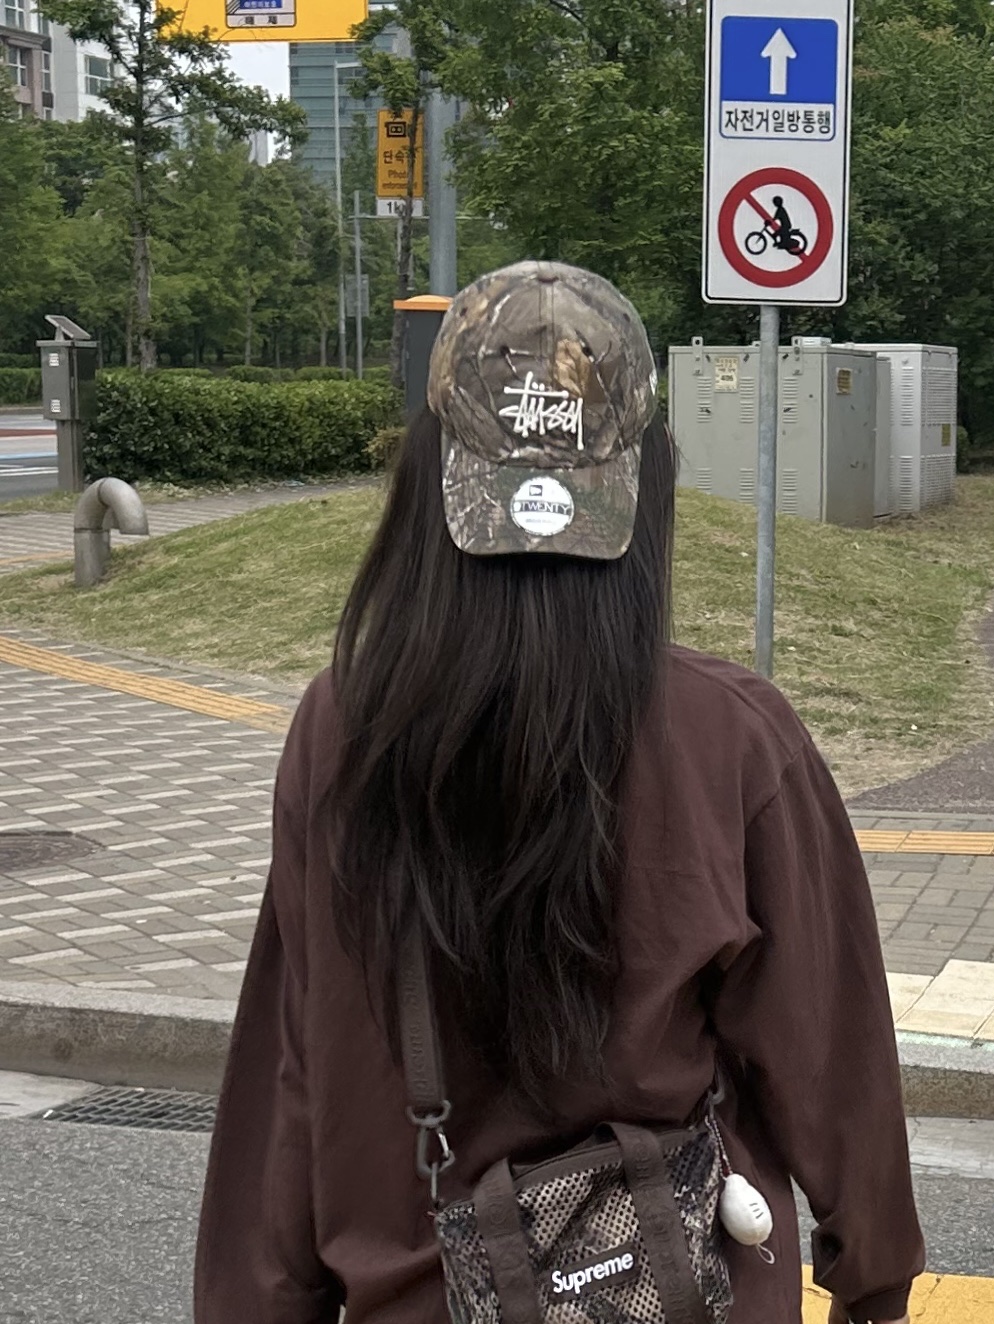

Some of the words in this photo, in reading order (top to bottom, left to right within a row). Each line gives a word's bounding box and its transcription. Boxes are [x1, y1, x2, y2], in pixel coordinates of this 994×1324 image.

[724, 108, 831, 134] 자전거일방통행
[383, 149, 416, 164] 단속
[551, 1251, 634, 1295] Supreme
